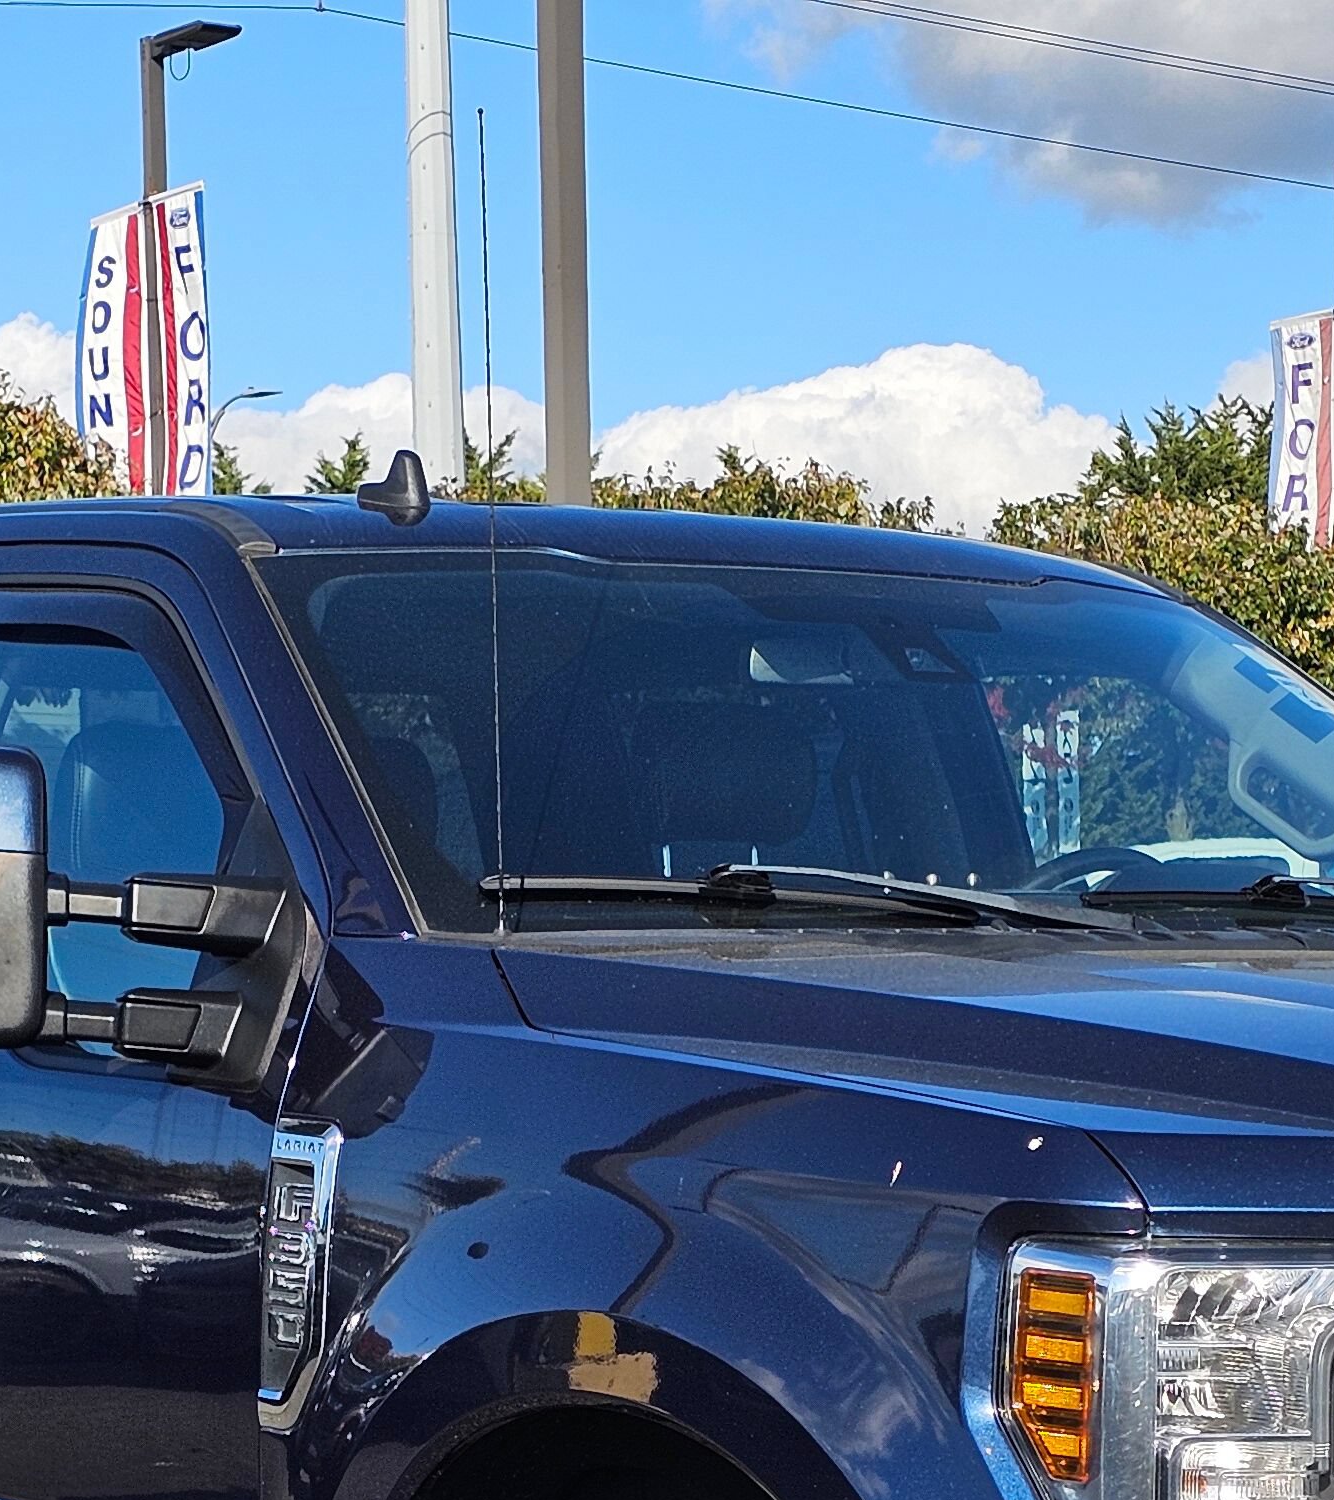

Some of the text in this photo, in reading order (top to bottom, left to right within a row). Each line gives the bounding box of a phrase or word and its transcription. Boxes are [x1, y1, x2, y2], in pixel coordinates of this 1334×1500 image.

[88, 255, 117, 429] SOUN
[173, 244, 207, 491] FORD
[1281, 362, 1316, 513] FOR
[276, 1137, 325, 1154] LARIAT
